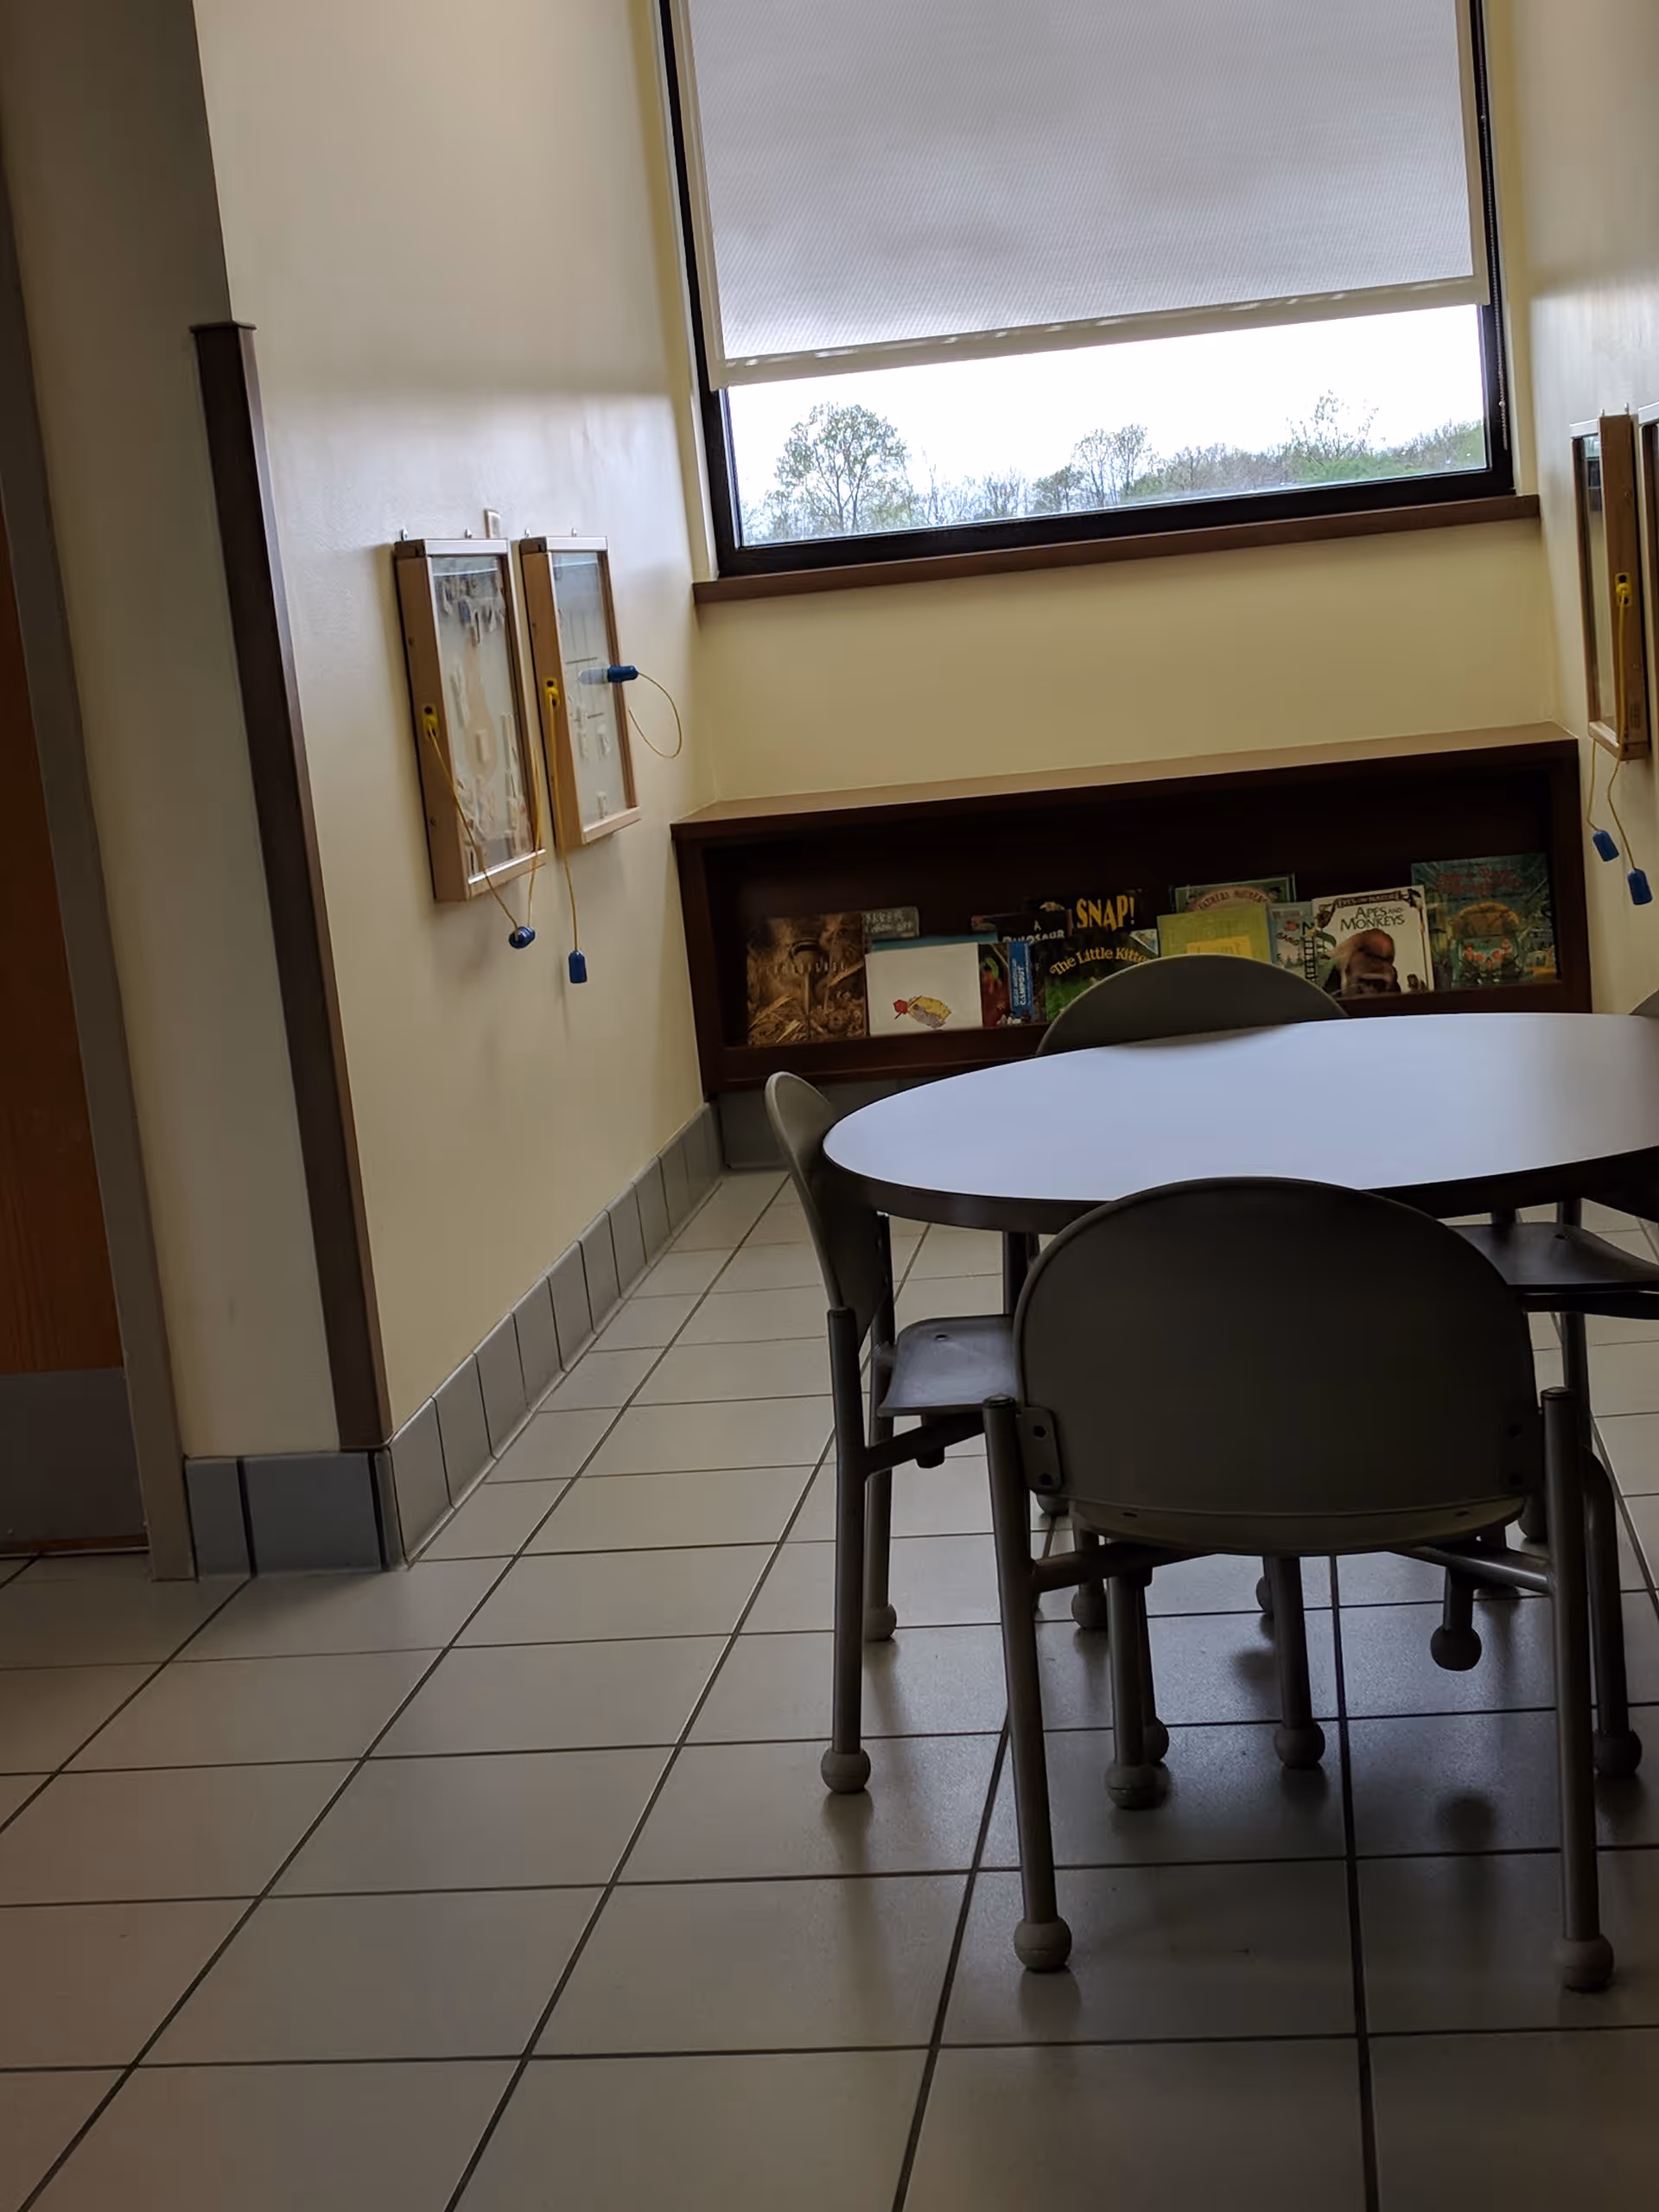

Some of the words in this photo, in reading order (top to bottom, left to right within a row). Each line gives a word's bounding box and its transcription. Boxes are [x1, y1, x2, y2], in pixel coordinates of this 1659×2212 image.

[1075, 894, 1135, 932] SNAP!
[1355, 906, 1387, 918] APES
[1033, 919, 1042, 931] A
[1340, 915, 1405, 931] MONKEYS
[1002, 929, 1065, 943] DINOSAUR
[1049, 957, 1077, 975] The
[1076, 947, 1113, 964] Little
[1018, 964, 1027, 1006] CAMPOUT
